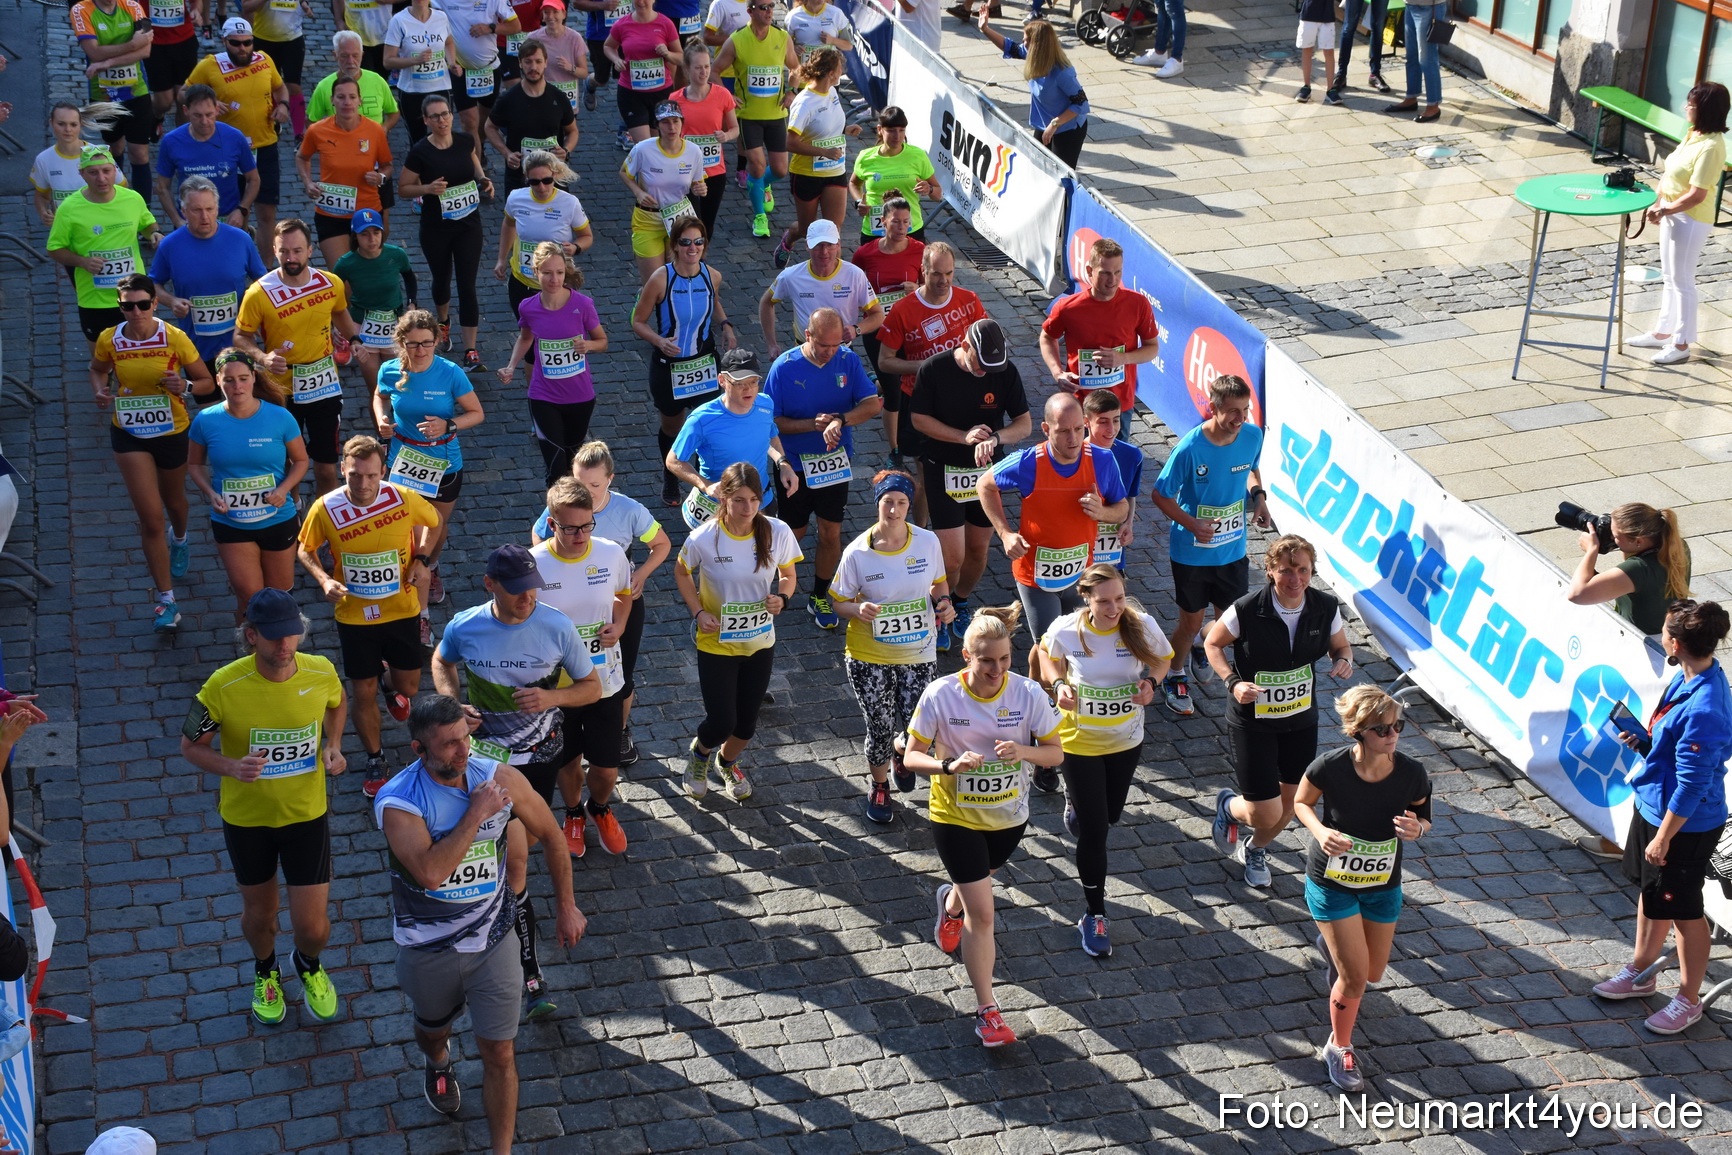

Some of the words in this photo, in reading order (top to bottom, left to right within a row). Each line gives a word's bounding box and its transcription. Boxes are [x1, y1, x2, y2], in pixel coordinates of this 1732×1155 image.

[154, 7, 182, 18] 2175
[417, 61, 442, 73] 2527
[632, 60, 662, 69] BOCK
[750, 67, 779, 75] BOCK
[224, 71, 248, 84] MAX
[250, 62, 270, 76] BÖGL
[634, 70, 661, 80] 2444
[555, 81, 577, 89] OCK
[751, 76, 778, 87] 2812
[938, 110, 992, 184] swn
[442, 182, 476, 201] BOCK
[318, 193, 351, 210] 2611
[446, 193, 477, 212] 2610
[970, 181, 1000, 219] neumarkt
[193, 295, 236, 308] BOCK
[277, 303, 305, 320] MAX
[308, 290, 338, 309] BÖGL
[1140, 287, 1164, 312] STORE
[198, 307, 232, 323] 2791
[115, 353, 138, 362] MAX
[142, 350, 168, 360] BÖGL
[544, 351, 581, 366] 2616
[298, 361, 331, 378] BOCK
[547, 364, 581, 376] SUSANNE
[674, 356, 711, 373] BOCK
[299, 370, 332, 392] 2371
[676, 369, 712, 387] 2591
[1084, 374, 1119, 386] REINHARD
[298, 385, 336, 401] CHRISTIAN
[684, 384, 708, 395] SILVIA
[120, 397, 165, 410] BOCK
[123, 410, 166, 426] 2400
[133, 426, 160, 436] MARIA
[403, 448, 444, 471] BOCK
[810, 455, 845, 476] 2032
[397, 461, 437, 483] 2481
[1231, 463, 1251, 473] BOCK
[227, 478, 269, 491] BOCK
[401, 477, 424, 491] IRENE
[814, 471, 845, 486] CLAUDIO
[236, 508, 268, 519] CARINA
[1202, 503, 1241, 518] BOCK
[339, 524, 371, 542] MAX
[373, 509, 409, 528] BÖGL
[1097, 524, 1118, 532] CK
[1212, 515, 1240, 533] 216
[1041, 547, 1083, 560] BOCK
[346, 554, 392, 567] BOCK
[906, 557, 916, 566] 20
[586, 566, 598, 576] 20
[907, 563, 929, 572] Neumarkter
[908, 569, 926, 578] Stadtlauf
[1041, 560, 1083, 577] 2807
[349, 567, 394, 584] 2380
[587, 573, 611, 581] Neumarkter
[588, 578, 608, 587] Stadtlauf
[353, 585, 392, 595] MICHAEL
[727, 611, 769, 631] 2219
[880, 614, 923, 635] 2313
[731, 628, 763, 642] KARINA
[882, 632, 923, 643] MARTINA
[468, 659, 528, 669] RAIL.ONE
[1260, 668, 1310, 685] BOCK
[1085, 686, 1133, 699] BOCK
[1263, 682, 1307, 703] 1038
[997, 708, 1009, 718] 20
[1085, 700, 1134, 717] 1396
[1267, 701, 1303, 714] ANDREA
[997, 715, 1025, 723] Neumarkter
[997, 721, 1020, 729] Stadtlauf
[257, 727, 313, 742] BOCK
[258, 742, 310, 763] 2632
[261, 761, 306, 774] MICHAEL
[965, 774, 1015, 793] 1037
[963, 791, 1014, 803] KATHARINA
[466, 843, 490, 859] CK
[1353, 841, 1393, 854] OCK
[1338, 855, 1388, 873] 1066
[443, 862, 490, 888] 494
[1334, 874, 1382, 884] JOSEFINE
[444, 887, 481, 899] TOLGA
